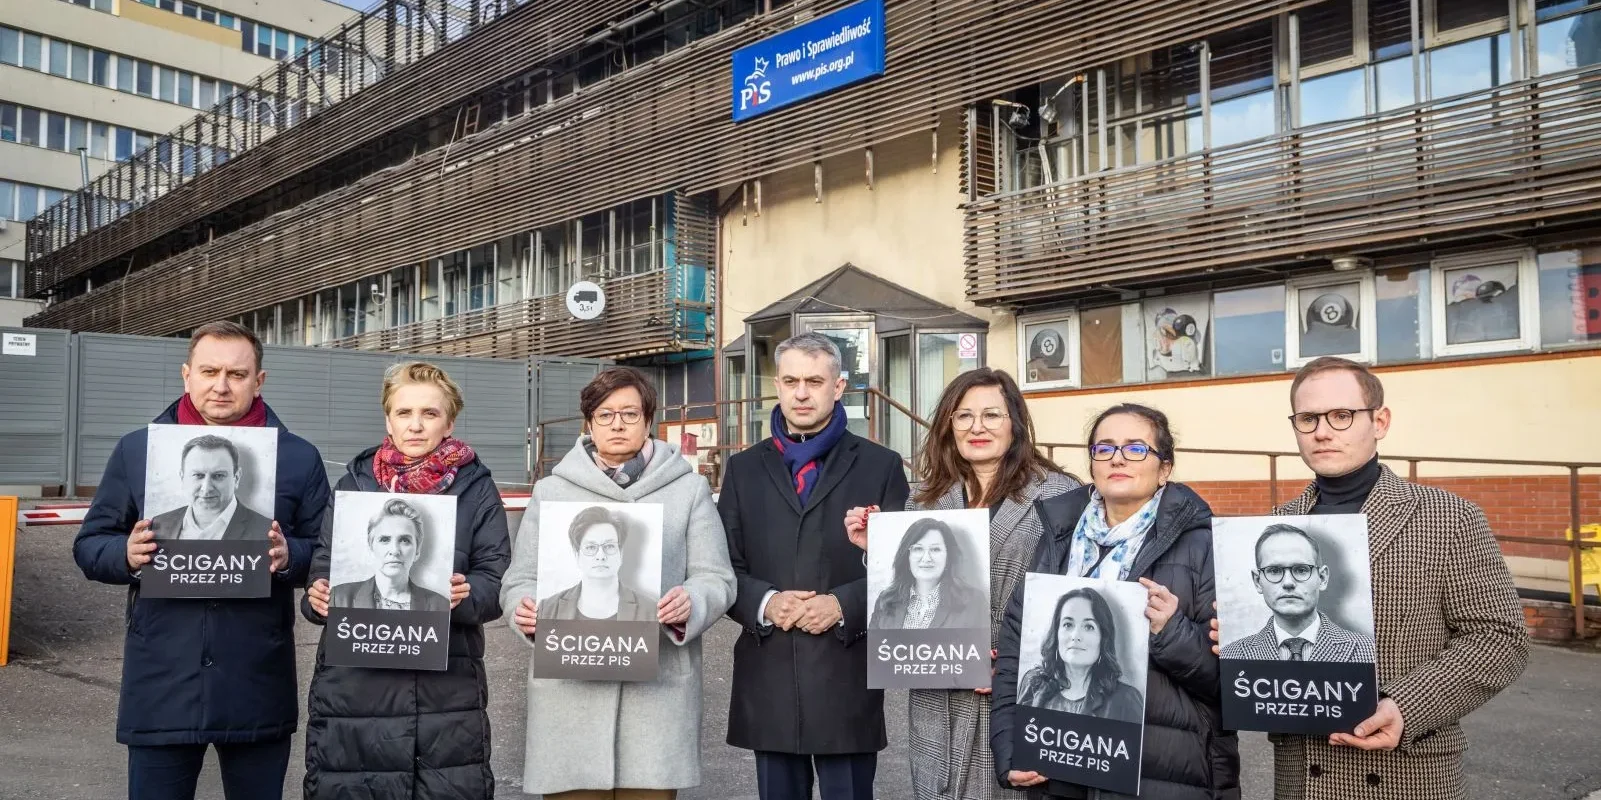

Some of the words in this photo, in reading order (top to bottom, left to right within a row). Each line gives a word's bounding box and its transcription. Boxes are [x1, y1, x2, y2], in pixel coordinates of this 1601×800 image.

[776, 50, 800, 68] Prawo
[802, 43, 806, 59] i
[807, 17, 871, 59] Sprawiedliwość
[791, 51, 854, 85] www.pis.org.pl
[1324, 305, 1338, 320] 8
[1044, 339, 1054, 353] 8
[153, 548, 261, 571] ŚCIGANY
[170, 573, 216, 584] PRZEZ
[220, 573, 243, 584] PIS
[337, 616, 438, 643] ŚCIGANA
[545, 628, 649, 653] ŚCIGANA
[352, 642, 395, 654] PRZEZ
[398, 644, 421, 655] PIS
[878, 638, 981, 661] ŚCIGANA
[561, 655, 605, 666] PRZEZ
[608, 655, 631, 667] PIS
[894, 664, 937, 675] PRZEZ
[941, 664, 963, 675] PIS
[1234, 670, 1363, 702] ŚCIGANY
[1255, 702, 1309, 717] PRZEZ
[1314, 704, 1342, 718] PIS
[1024, 717, 1130, 760] ŚCIGANA
[1039, 748, 1084, 768] PRZEZ
[1087, 757, 1110, 772] PIS
